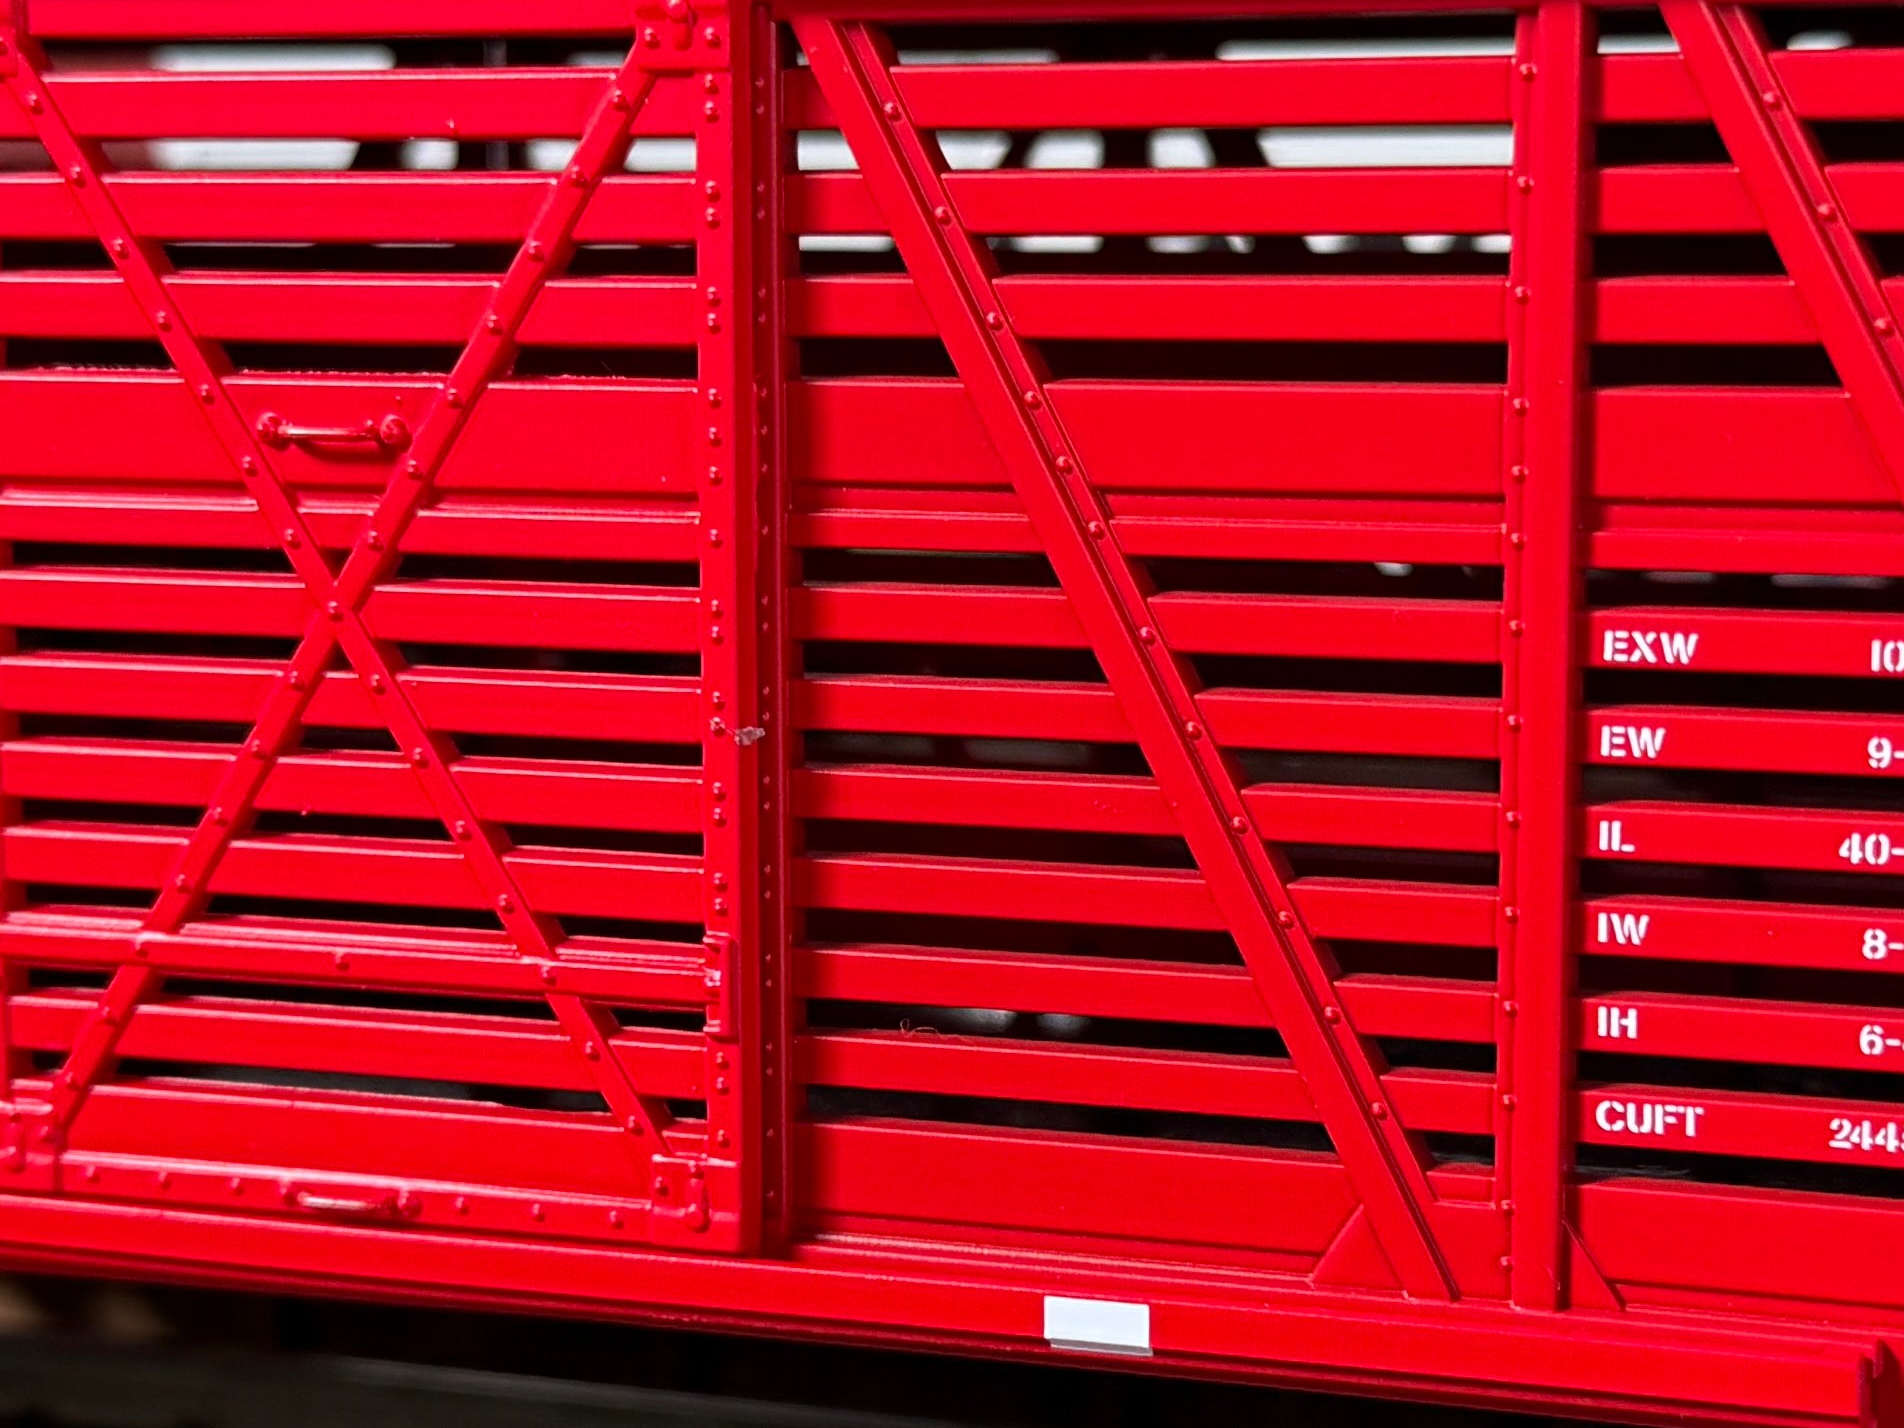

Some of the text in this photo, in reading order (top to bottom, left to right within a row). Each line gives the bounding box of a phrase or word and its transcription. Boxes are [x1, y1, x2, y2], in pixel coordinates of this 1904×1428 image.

[1602, 629, 1698, 665] EXW
[1600, 725, 1666, 760] EW
[1598, 820, 1635, 854] IL
[1596, 913, 1650, 947] IW
[1596, 1005, 1638, 1040] IH
[1595, 1099, 1705, 1137] CUFT
